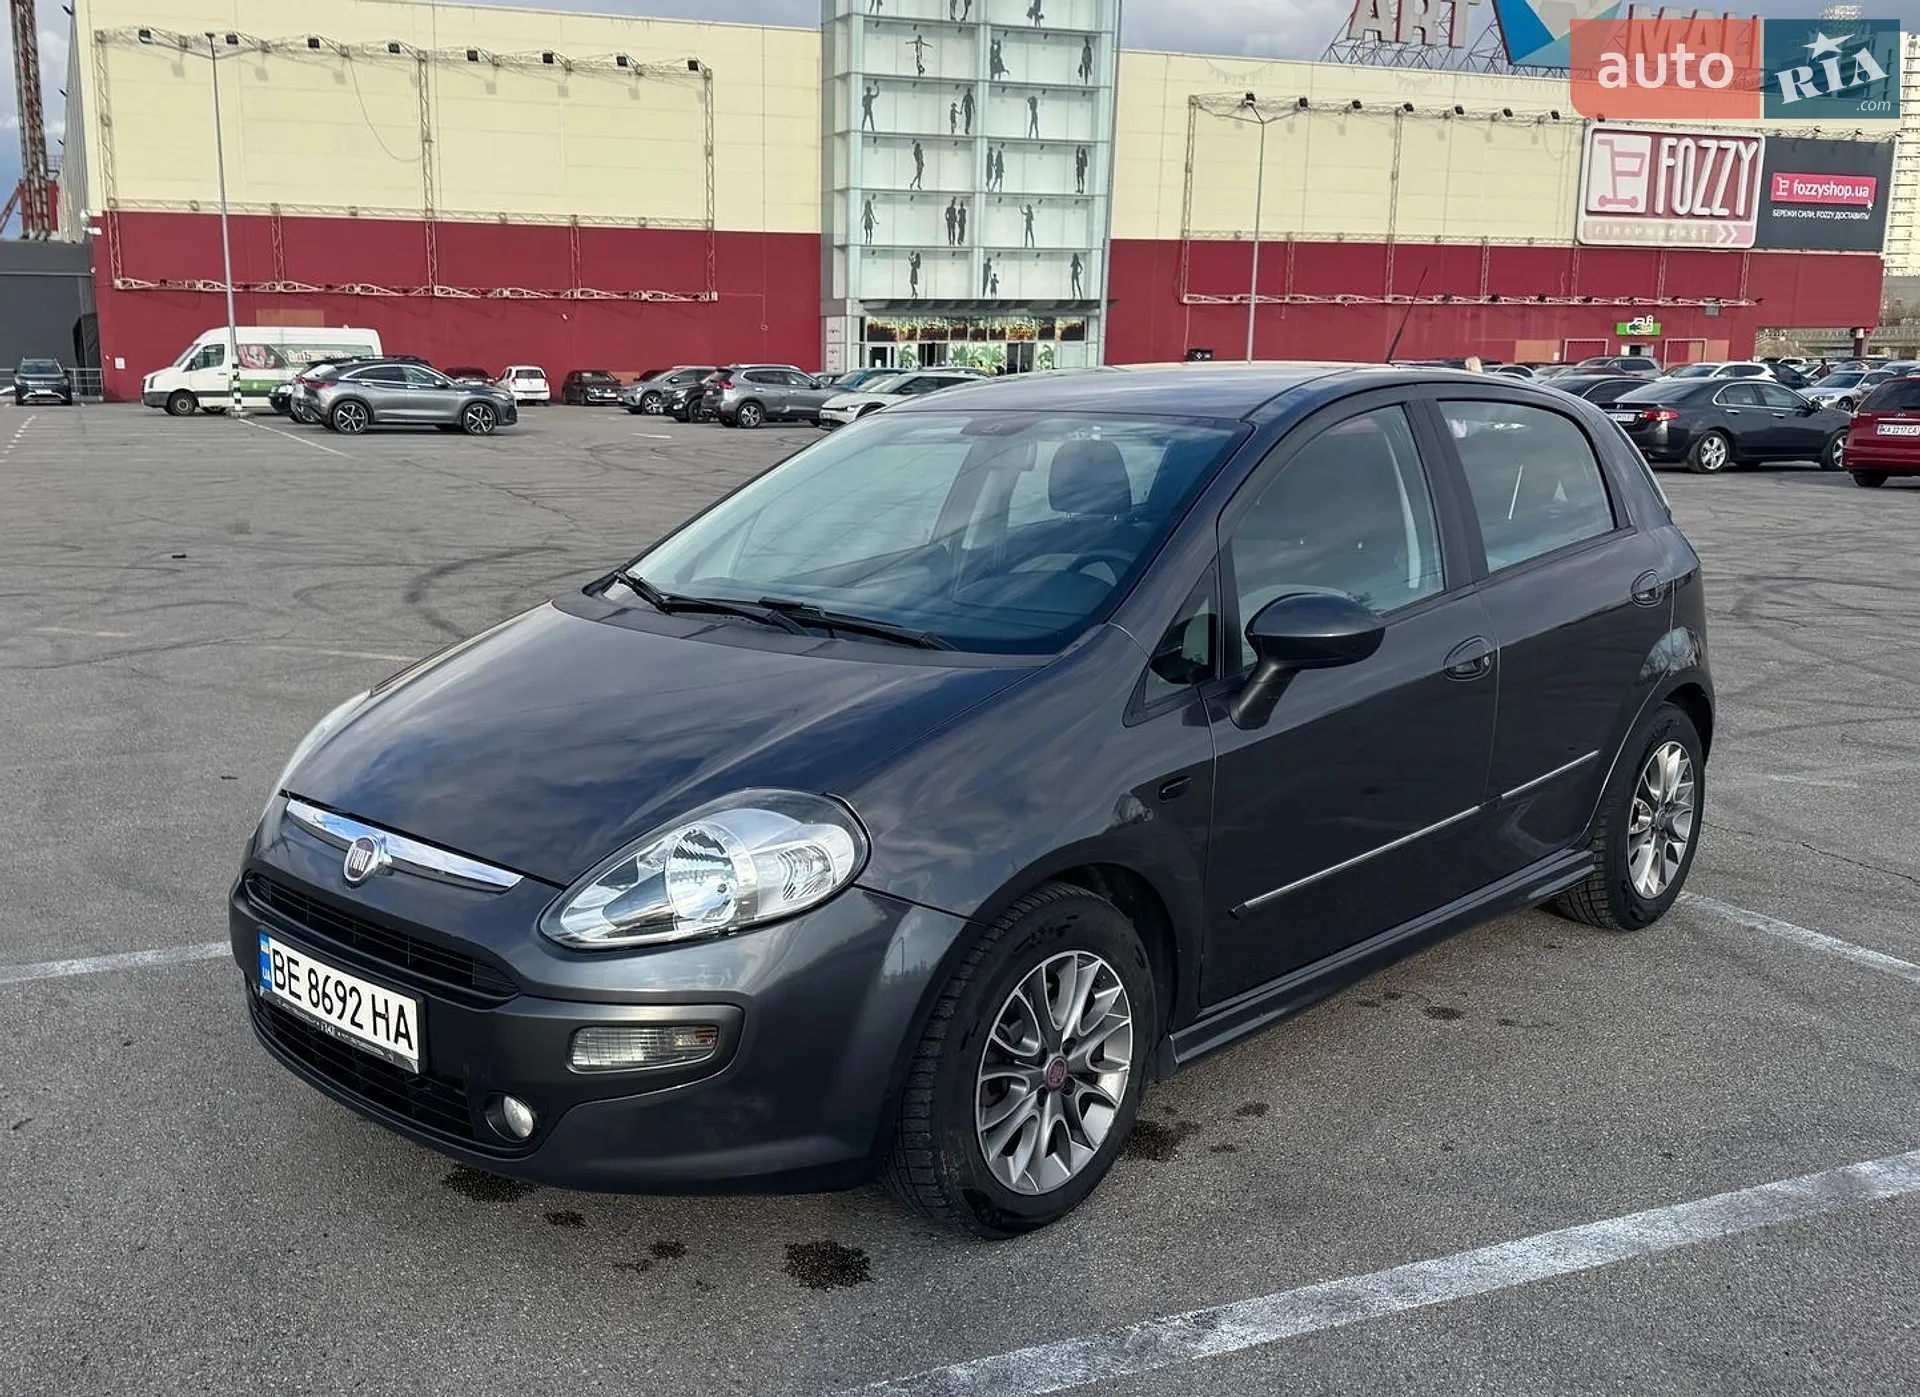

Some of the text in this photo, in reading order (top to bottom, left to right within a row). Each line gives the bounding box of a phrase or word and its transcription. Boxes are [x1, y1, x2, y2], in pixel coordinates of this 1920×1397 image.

[1346, 0, 1481, 48] ART
[1654, 136, 1759, 217] FOZZY
[1793, 179, 1870, 200] fozzyshop.ua
[350, 848, 372, 872] FIAT
[272, 948, 301, 1001] BE
[308, 968, 363, 1030] 8692
[371, 993, 413, 1050] HA
